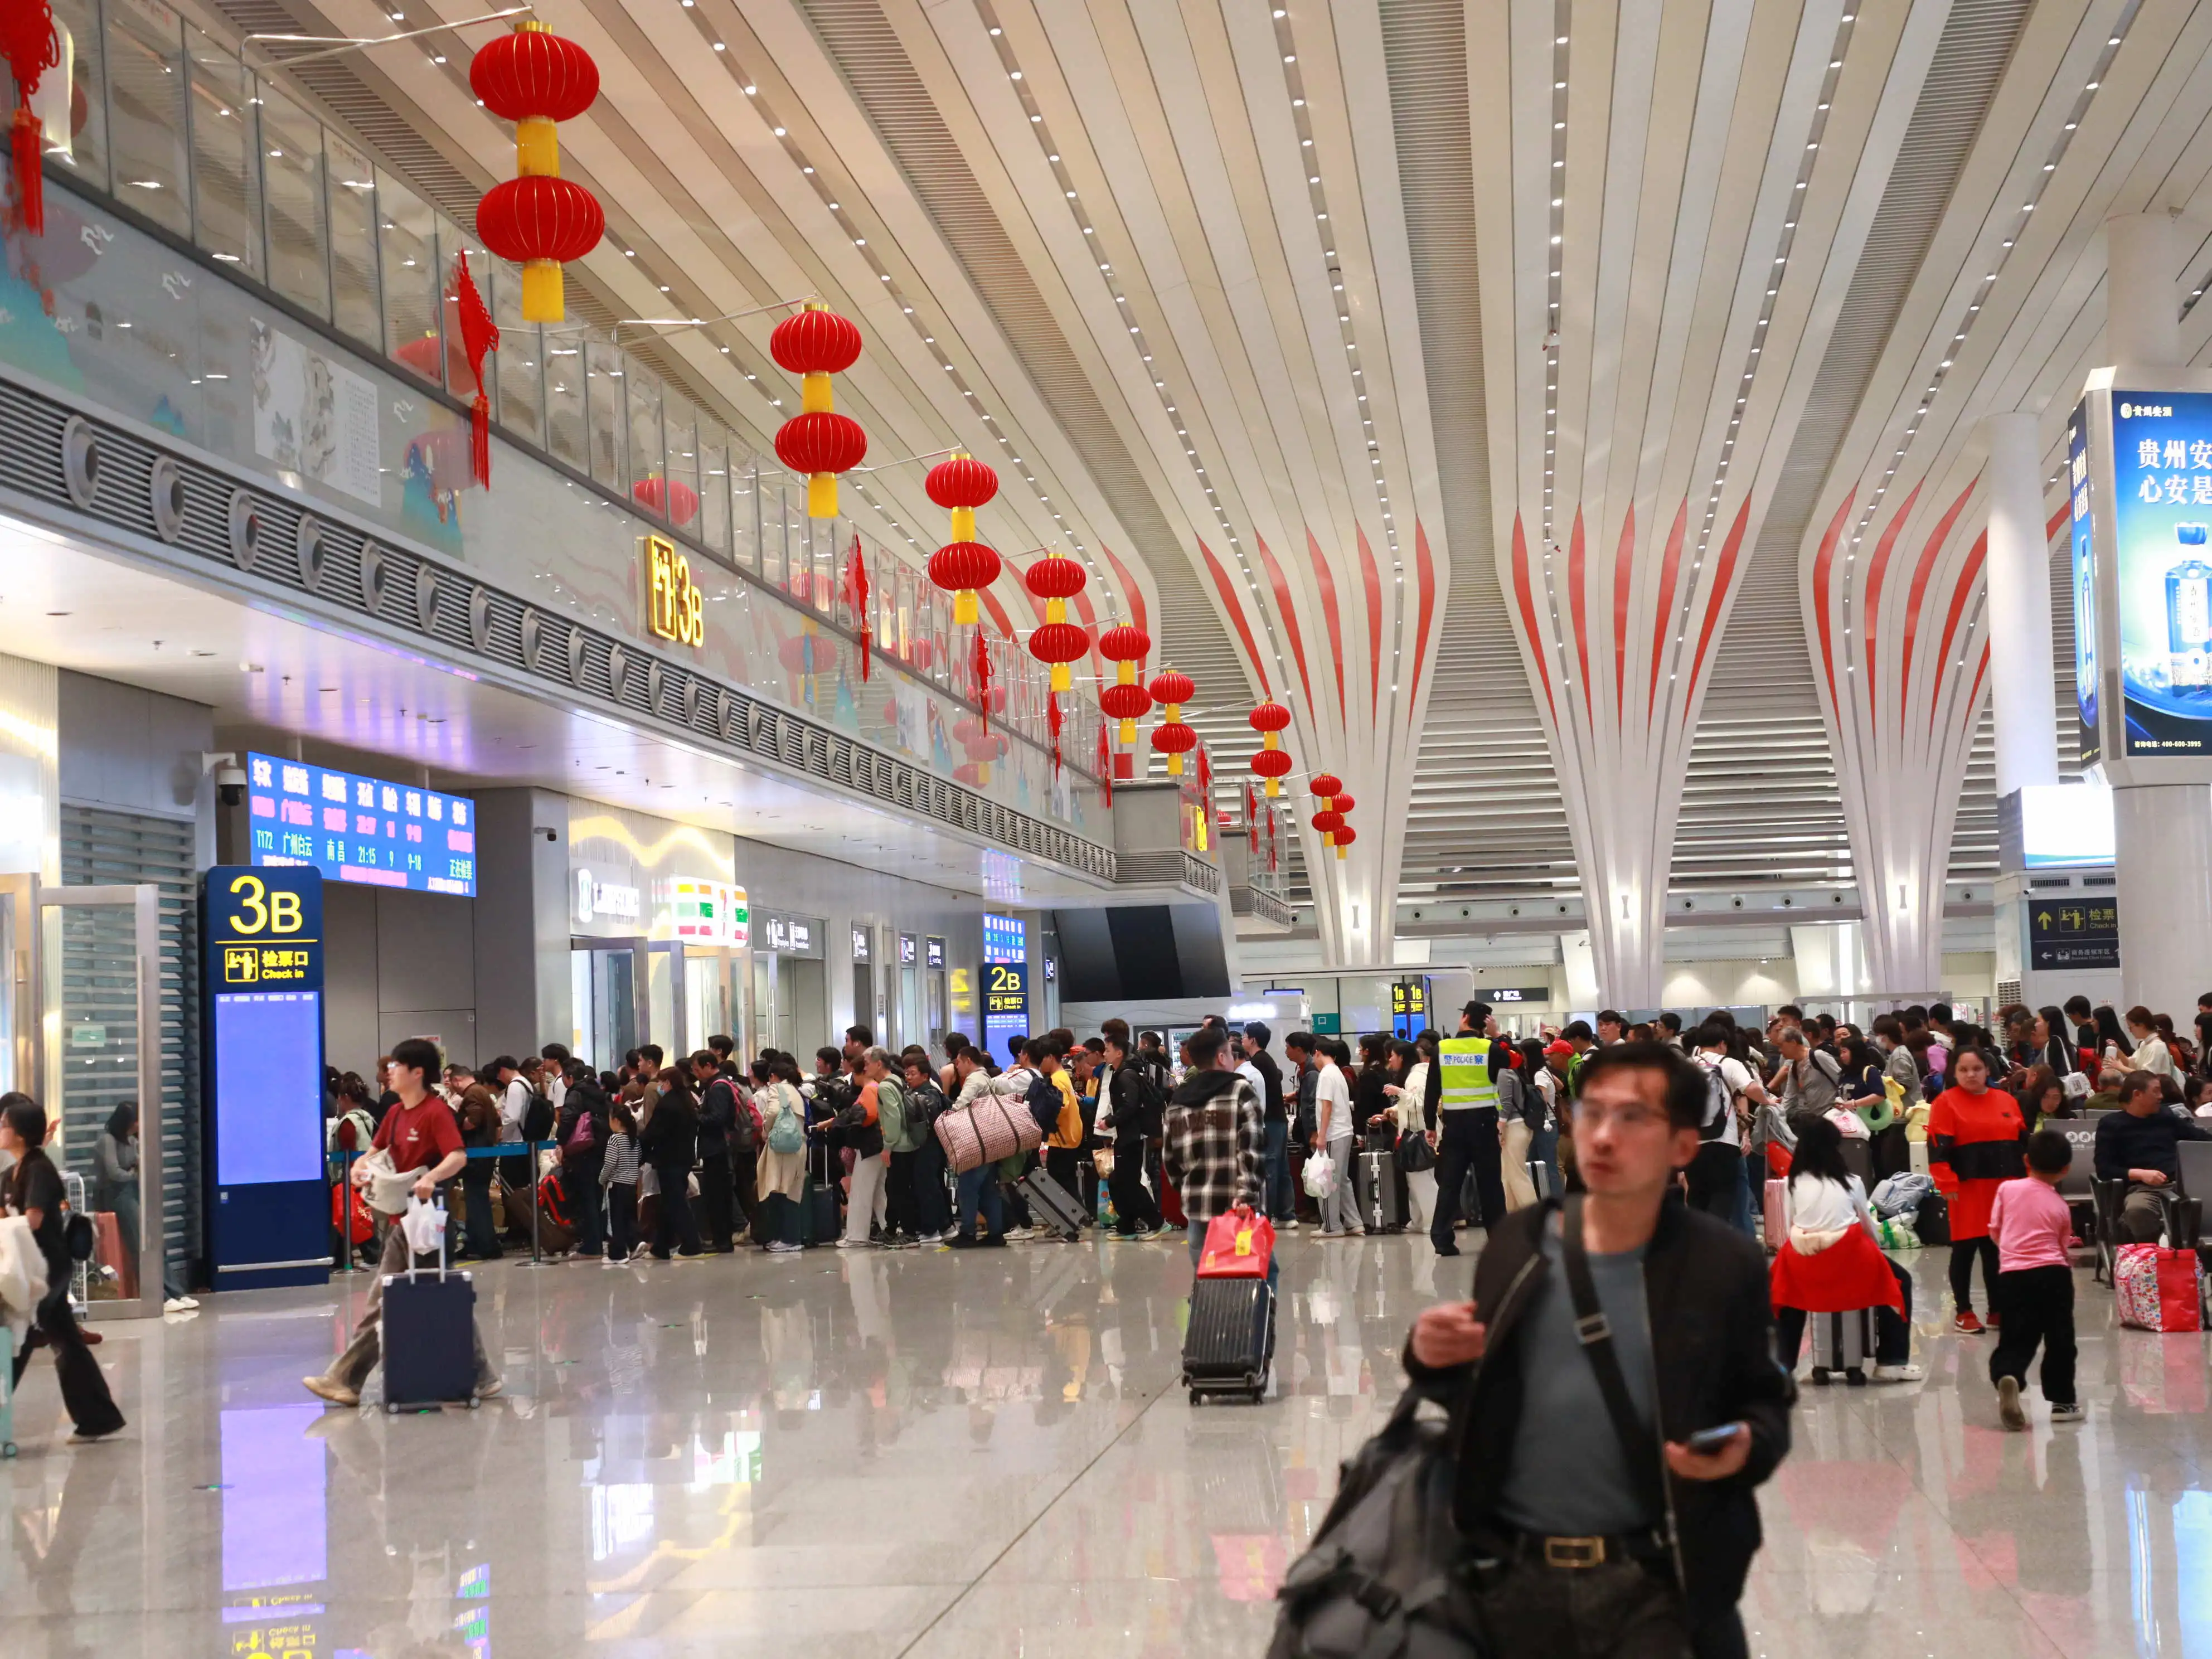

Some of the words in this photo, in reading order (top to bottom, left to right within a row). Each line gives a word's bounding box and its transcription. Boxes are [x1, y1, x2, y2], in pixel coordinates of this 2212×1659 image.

[2137, 439, 2212, 469] 贵州安
[2138, 475, 2212, 505] 心安是
[677, 555, 704, 648] 3B
[256, 830, 274, 850] T172
[282, 831, 313, 857] 广州白云
[357, 846, 377, 865] 21:15
[389, 851, 394, 867] 9
[408, 853, 421, 871] 9-18
[449, 858, 473, 880] 正在检票
[230, 875, 303, 935] 3B
[2089, 909, 2114, 921] 检票
[261, 950, 308, 968] 检票口
[261, 969, 293, 979] Check
[295, 969, 304, 978] in
[991, 966, 1021, 991] 2B
[1394, 985, 1404, 1001] 1B
[1410, 984, 1422, 1000] 1B
[1474, 1055, 1484, 1065] 察
